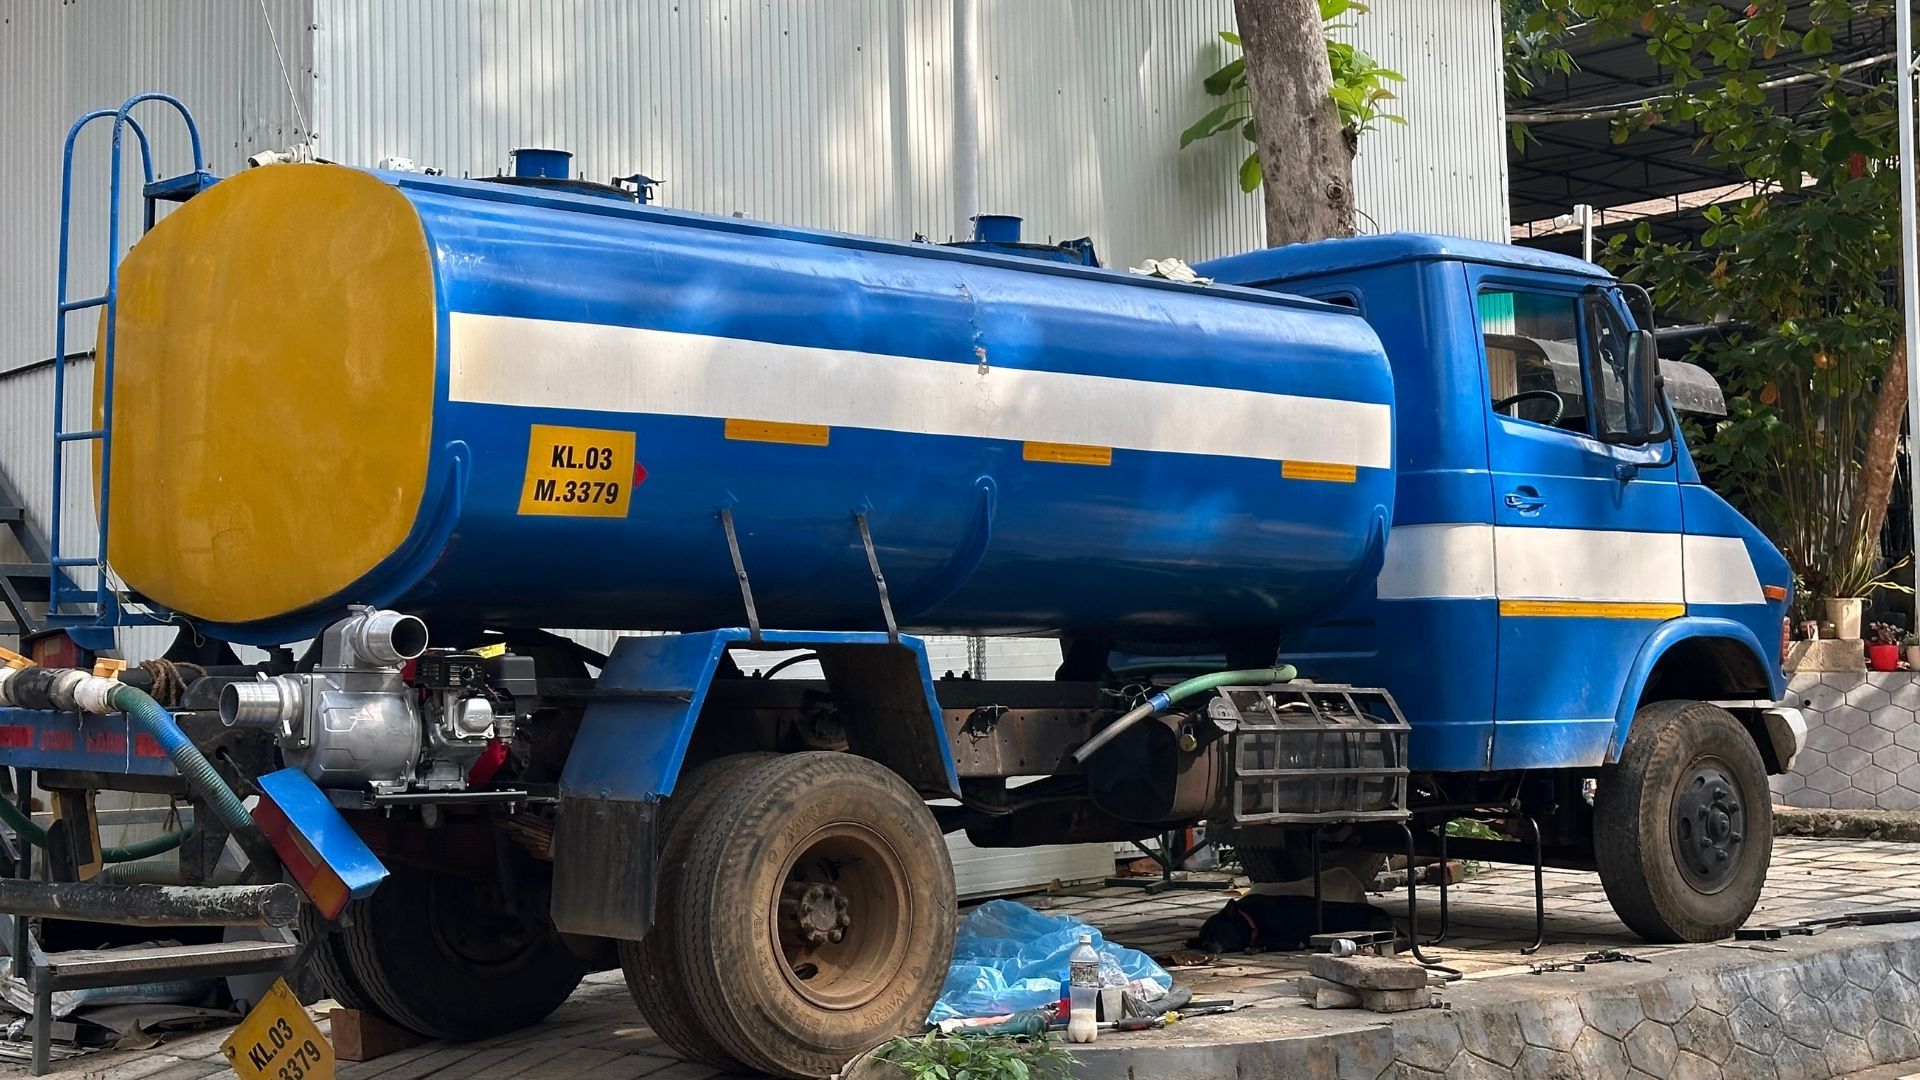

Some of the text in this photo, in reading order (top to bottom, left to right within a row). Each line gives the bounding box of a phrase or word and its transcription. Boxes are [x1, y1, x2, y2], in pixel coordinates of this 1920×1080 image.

[551, 445, 613, 470] KL.03
[533, 479, 619, 504] M.3379
[248, 1017, 293, 1073] KL.03
